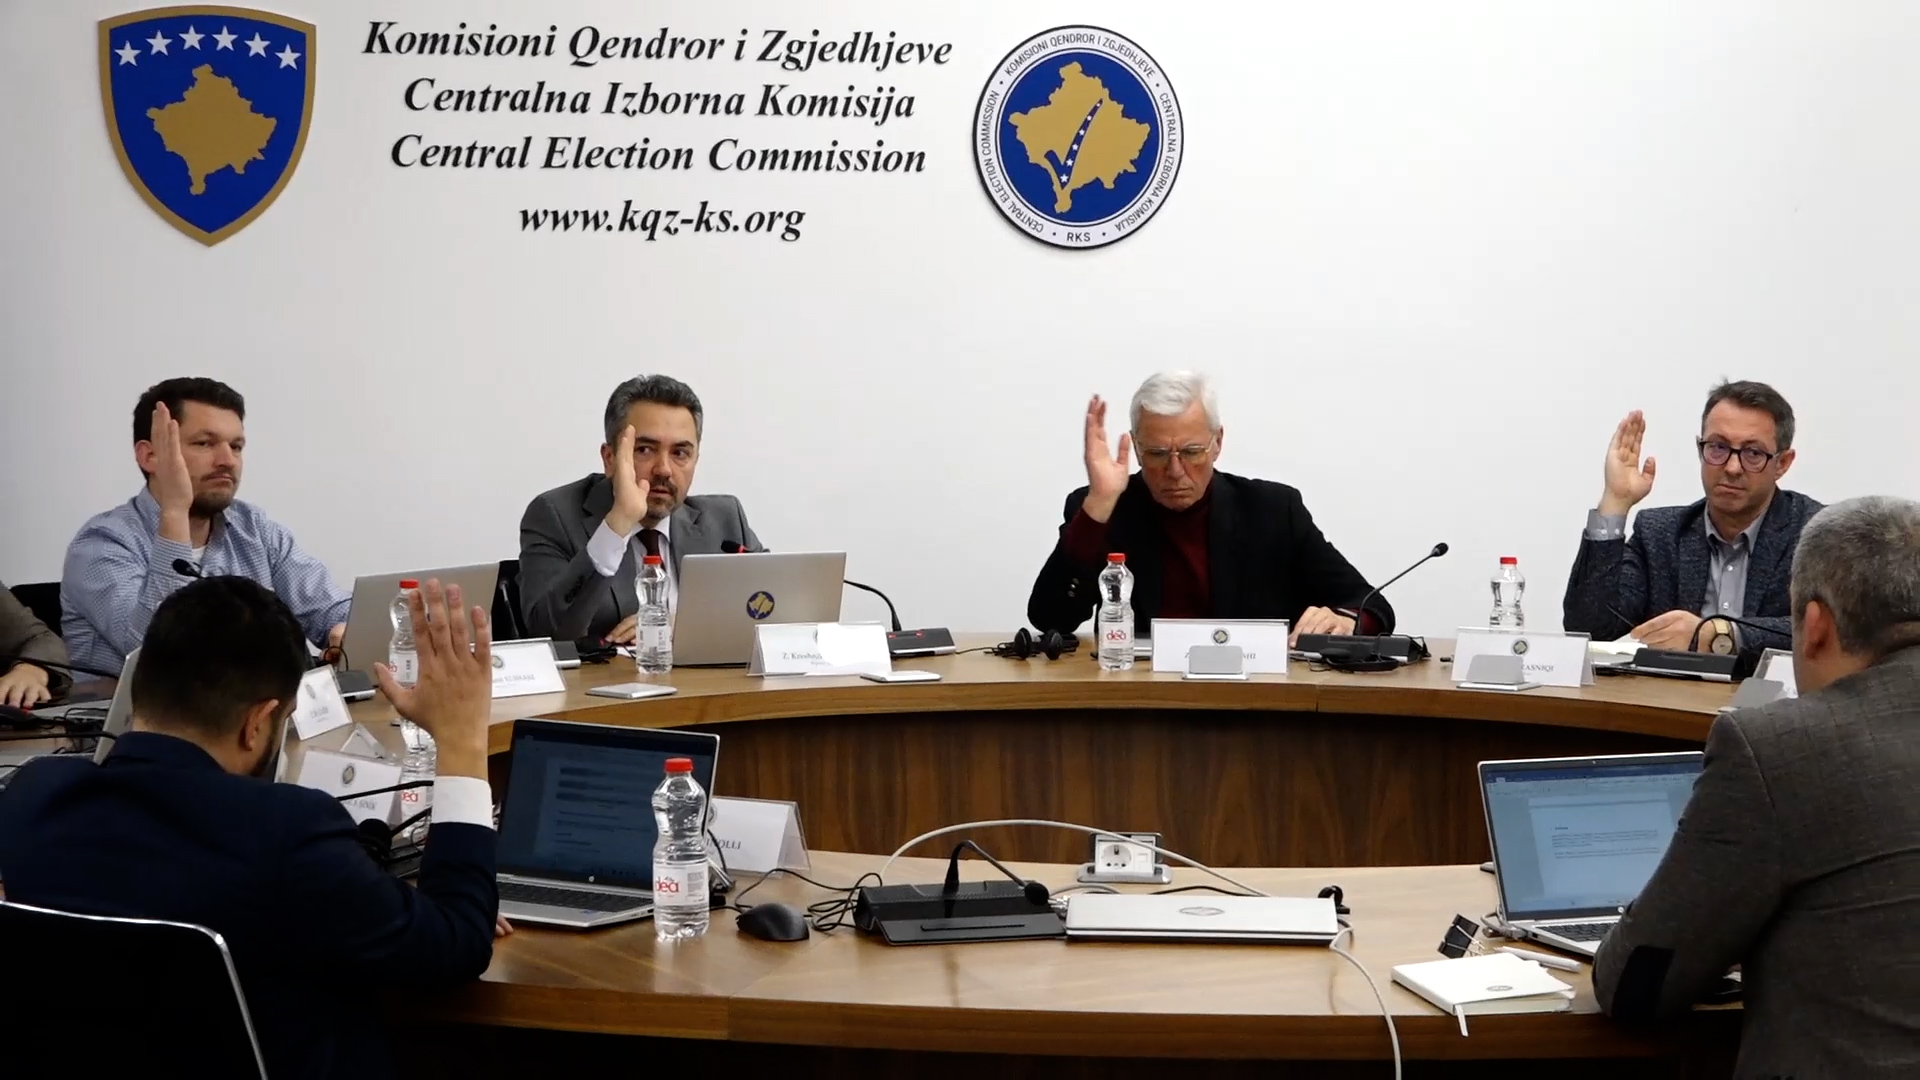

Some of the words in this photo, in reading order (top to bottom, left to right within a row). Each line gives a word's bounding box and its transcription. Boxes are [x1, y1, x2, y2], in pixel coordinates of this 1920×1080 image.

[361, 21, 558, 57] Komisioni
[568, 25, 725, 68] Qendror
[732, 28, 747, 61] i
[756, 29, 953, 72] Zgjedhjeve
[1004, 39, 1049, 76] KOMISIONI
[1050, 33, 1095, 47] QENDROR
[1103, 36, 1155, 79] ZGJEDHJEVE
[404, 77, 591, 114] Centralna
[601, 82, 745, 118] Izborna
[756, 84, 915, 126] Komisija
[981, 90, 1000, 155] COMMISSION
[1160, 92, 1176, 153] CENTRALNA
[391, 134, 532, 169] Central
[541, 136, 694, 171] Election
[708, 138, 926, 173] Commission
[984, 158, 1010, 204] ELECTION
[1151, 155, 1175, 198] IZBORNA
[519, 199, 806, 242] www.kqz-ks.org
[1007, 200, 1044, 233] CENTRAL
[1115, 196, 1155, 231] KOMISIJA
[1066, 232, 1091, 242] RKS
